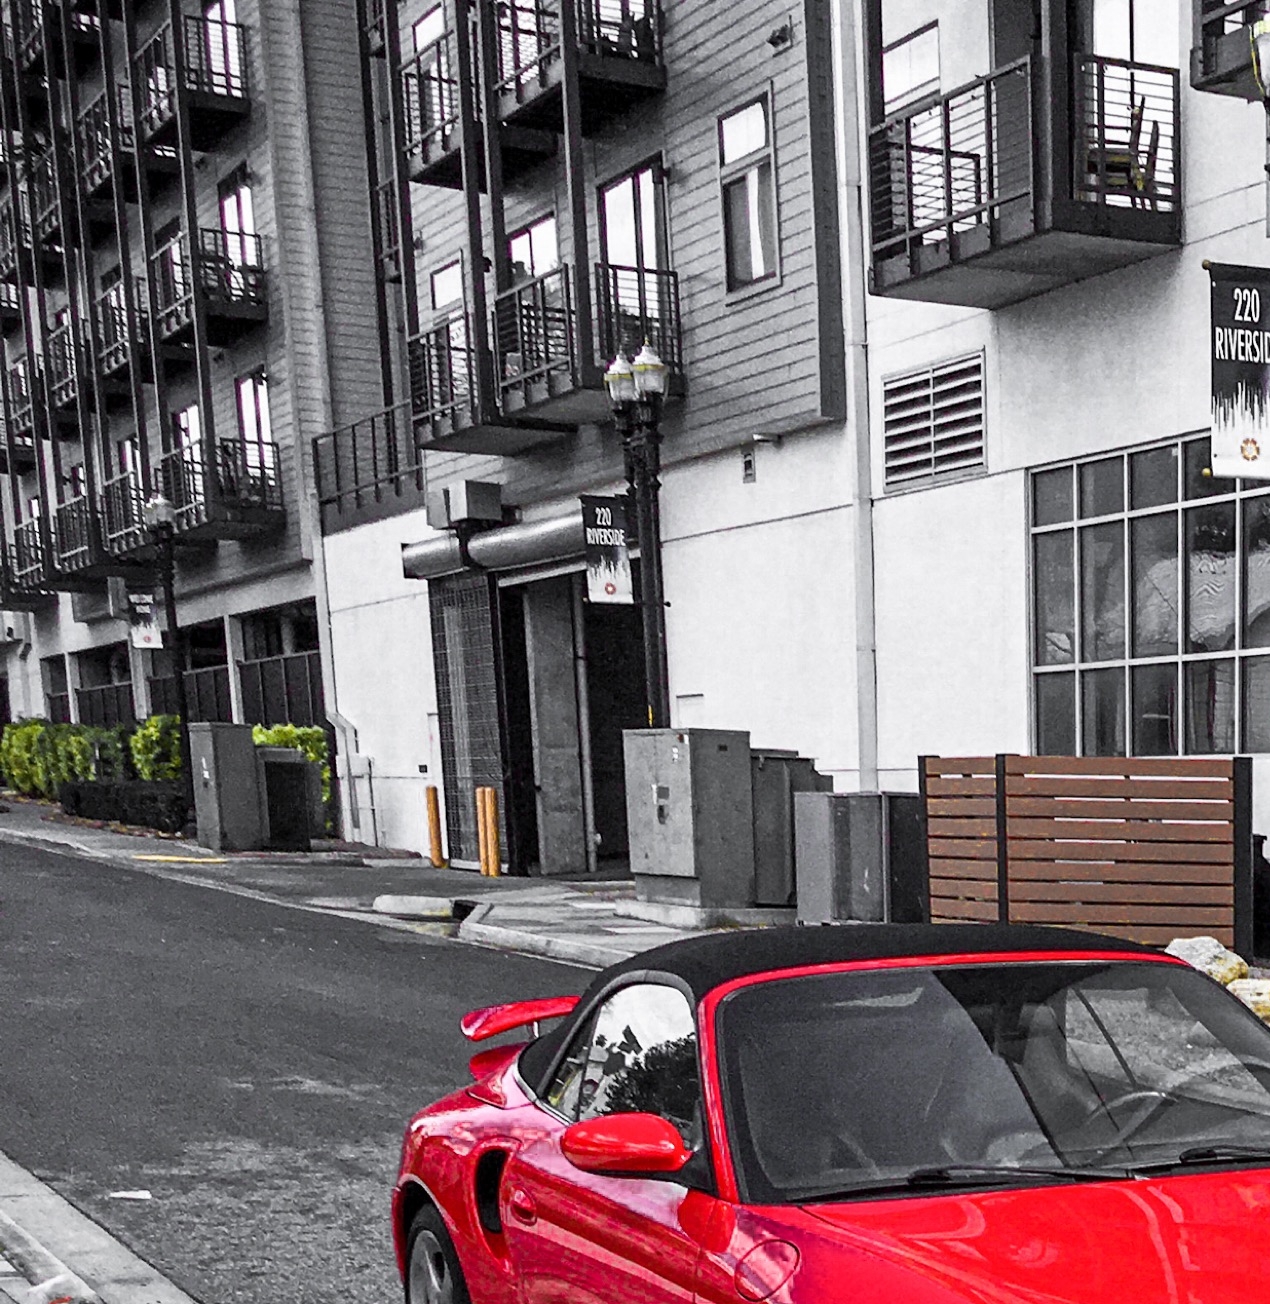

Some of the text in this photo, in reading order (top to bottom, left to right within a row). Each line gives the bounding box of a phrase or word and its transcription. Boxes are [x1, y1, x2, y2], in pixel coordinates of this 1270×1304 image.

[1234, 287, 1260, 323] 220
[595, 507, 612, 526] 220
[586, 527, 626, 546] RIVERSIDE
